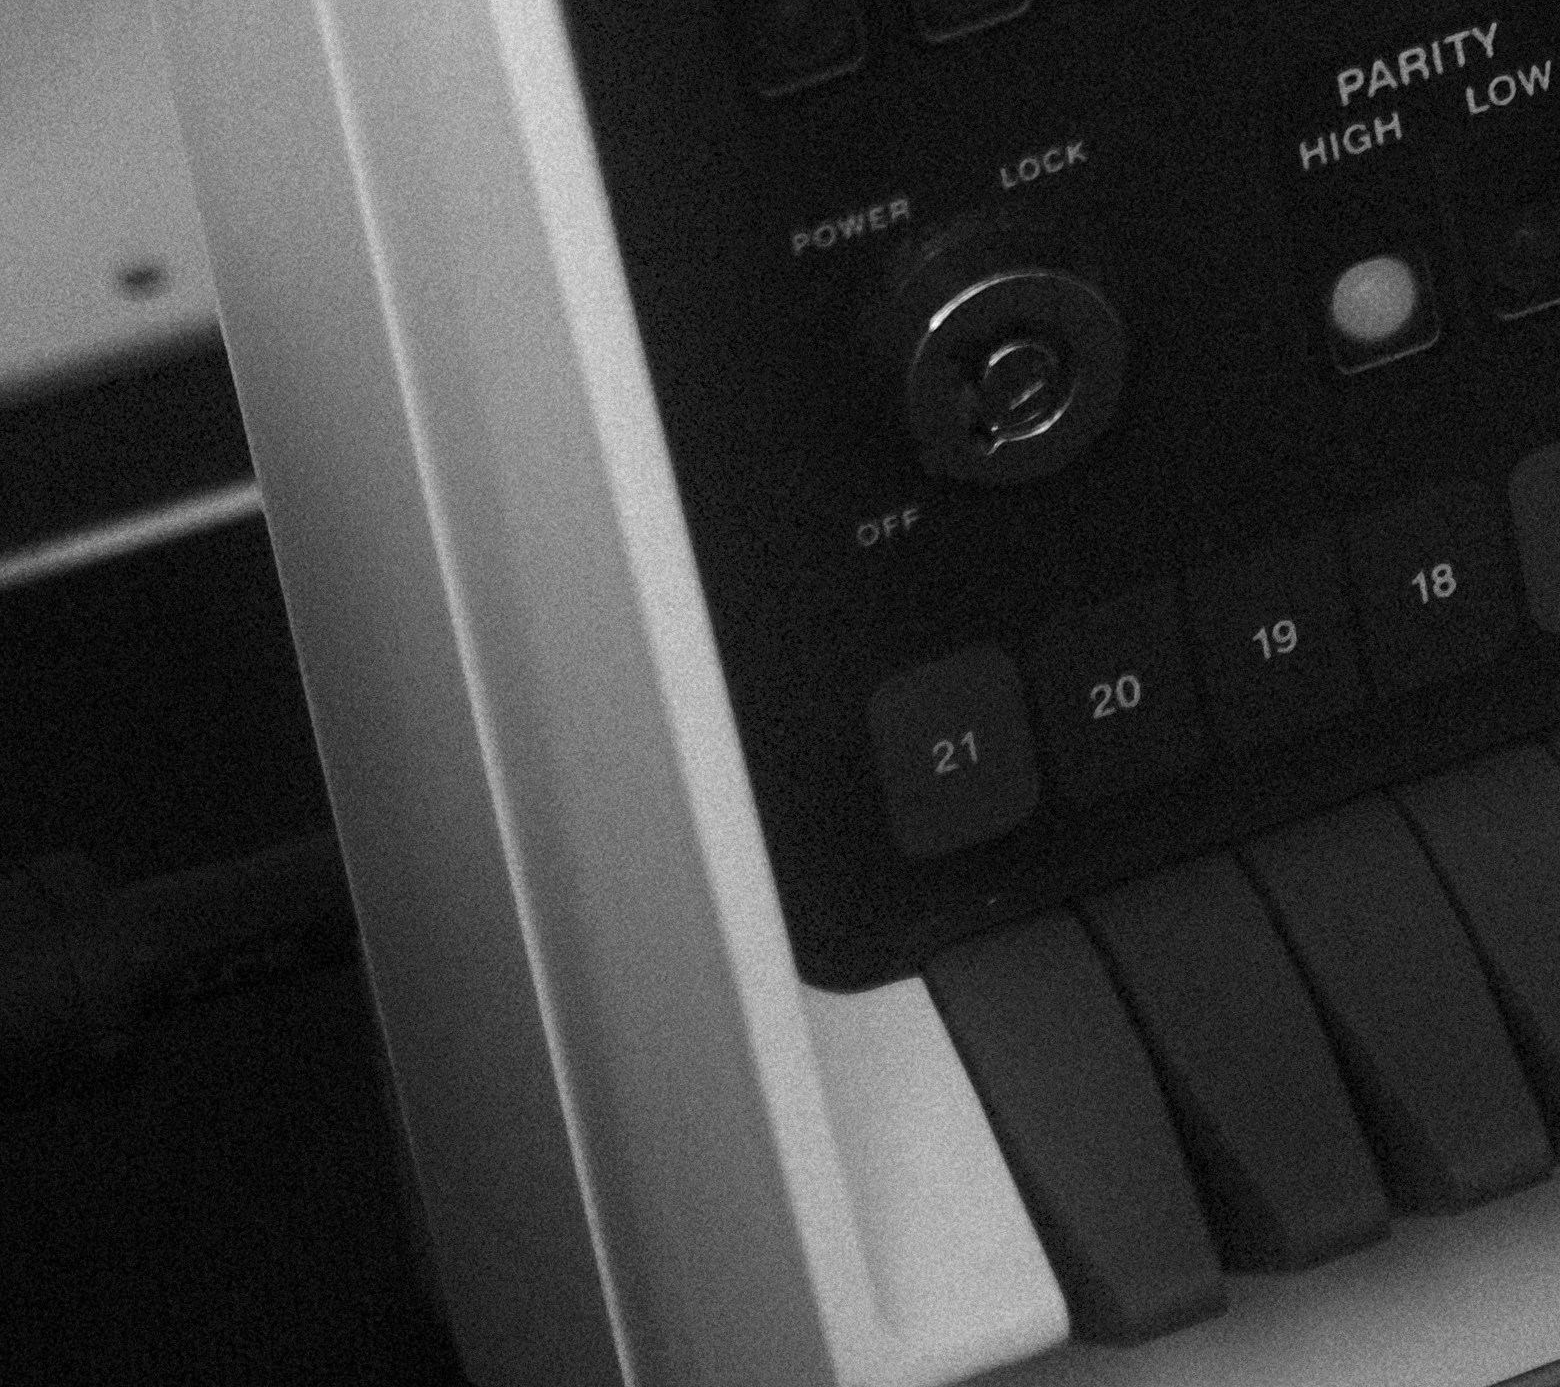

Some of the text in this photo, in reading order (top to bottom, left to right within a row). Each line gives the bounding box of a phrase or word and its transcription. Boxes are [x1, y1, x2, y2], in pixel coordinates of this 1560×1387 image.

[1337, 22, 1499, 105] PARITY
[1299, 60, 1552, 170] HIGH LOW
[999, 140, 1087, 190] LOCK
[791, 197, 910, 254] POWER
[856, 507, 919, 548] OFF
[931, 730, 978, 775] 21
[1089, 674, 1142, 719] 20
[1253, 619, 1298, 660] 19
[1411, 562, 1457, 603] 18
